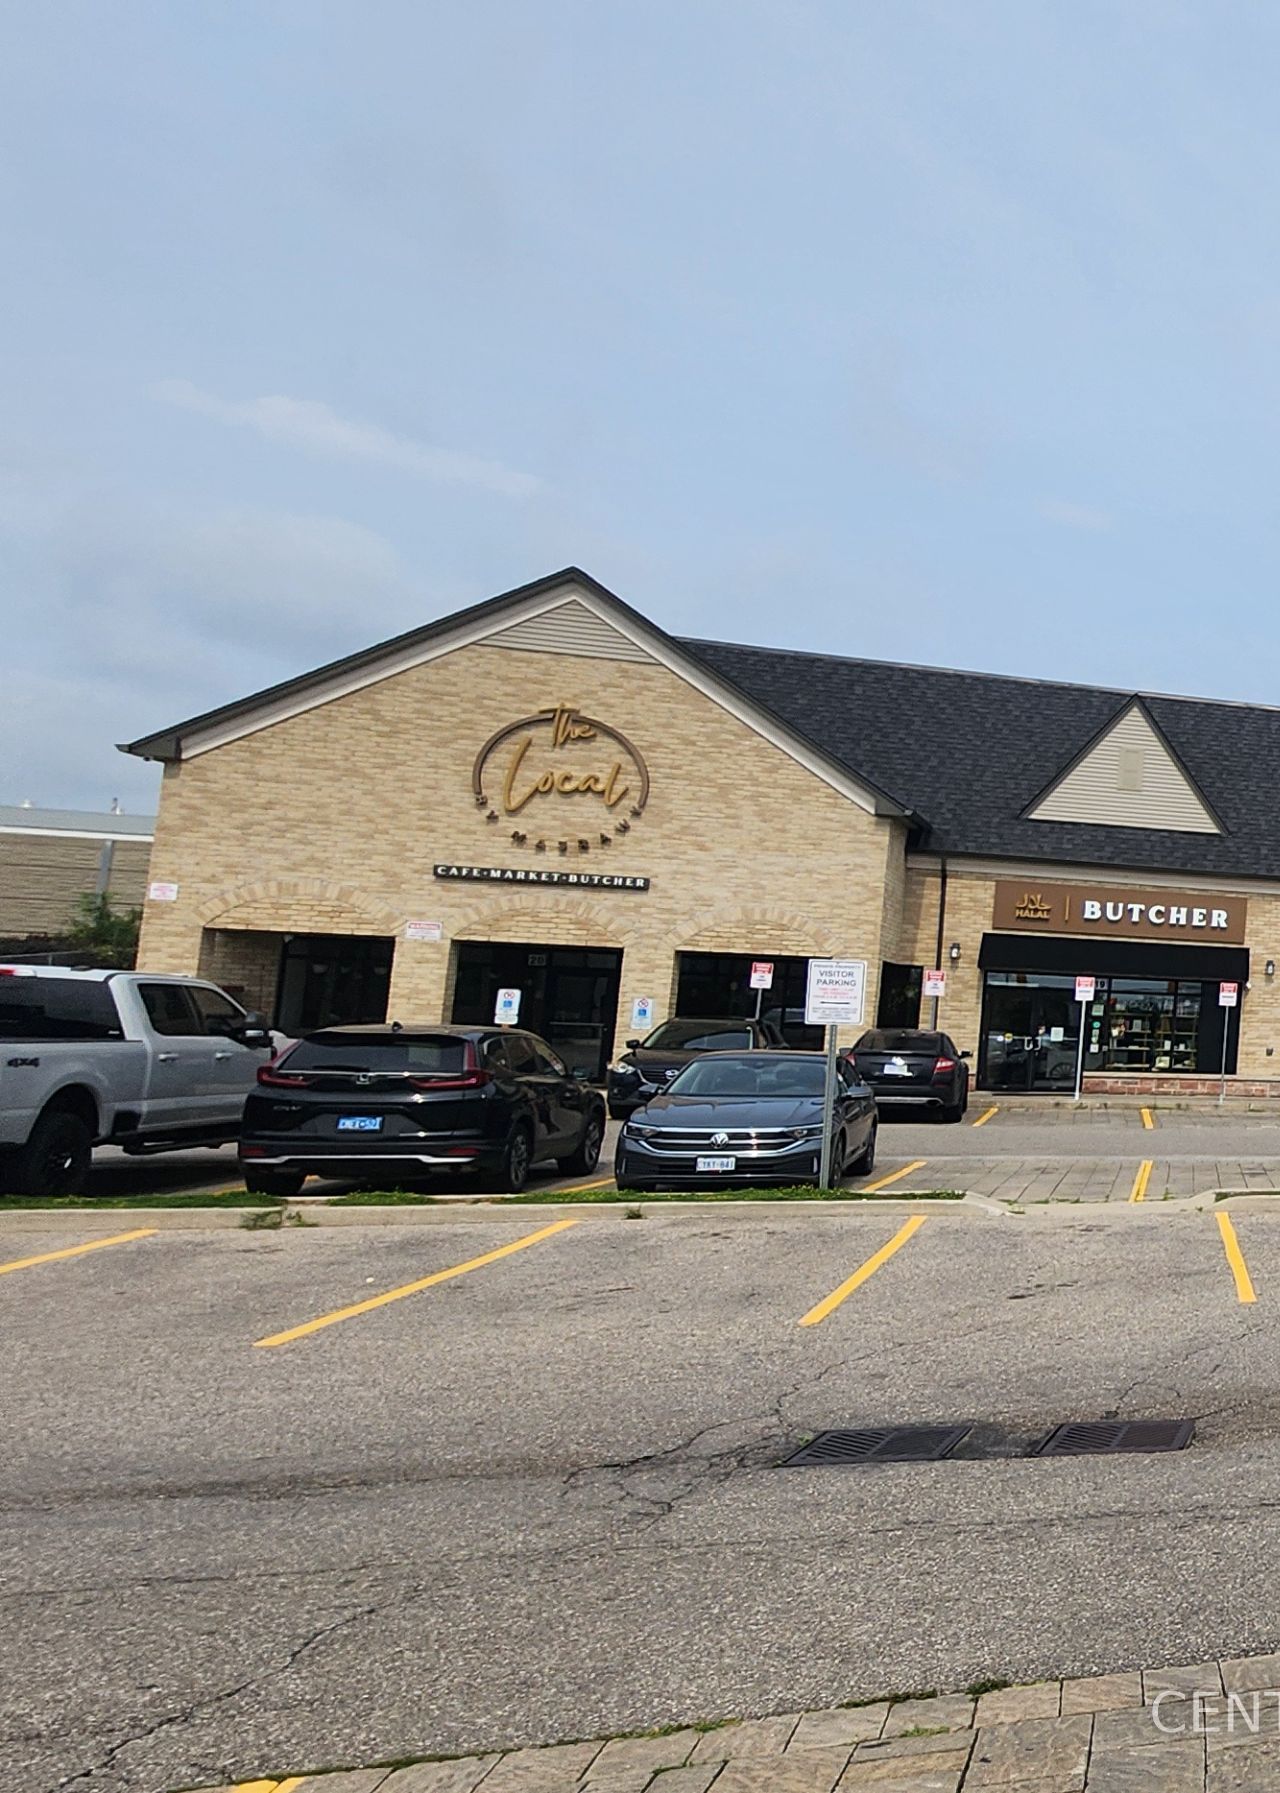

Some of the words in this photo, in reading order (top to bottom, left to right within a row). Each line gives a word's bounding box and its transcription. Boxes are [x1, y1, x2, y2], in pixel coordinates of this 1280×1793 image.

[538, 702, 597, 747] The
[503, 737, 629, 812] Local
[1015, 908, 1050, 919] HALAL
[1083, 900, 1228, 928] BUTCHER
[816, 979, 856, 987] PARKING
[818, 970, 854, 978] VISITOR
